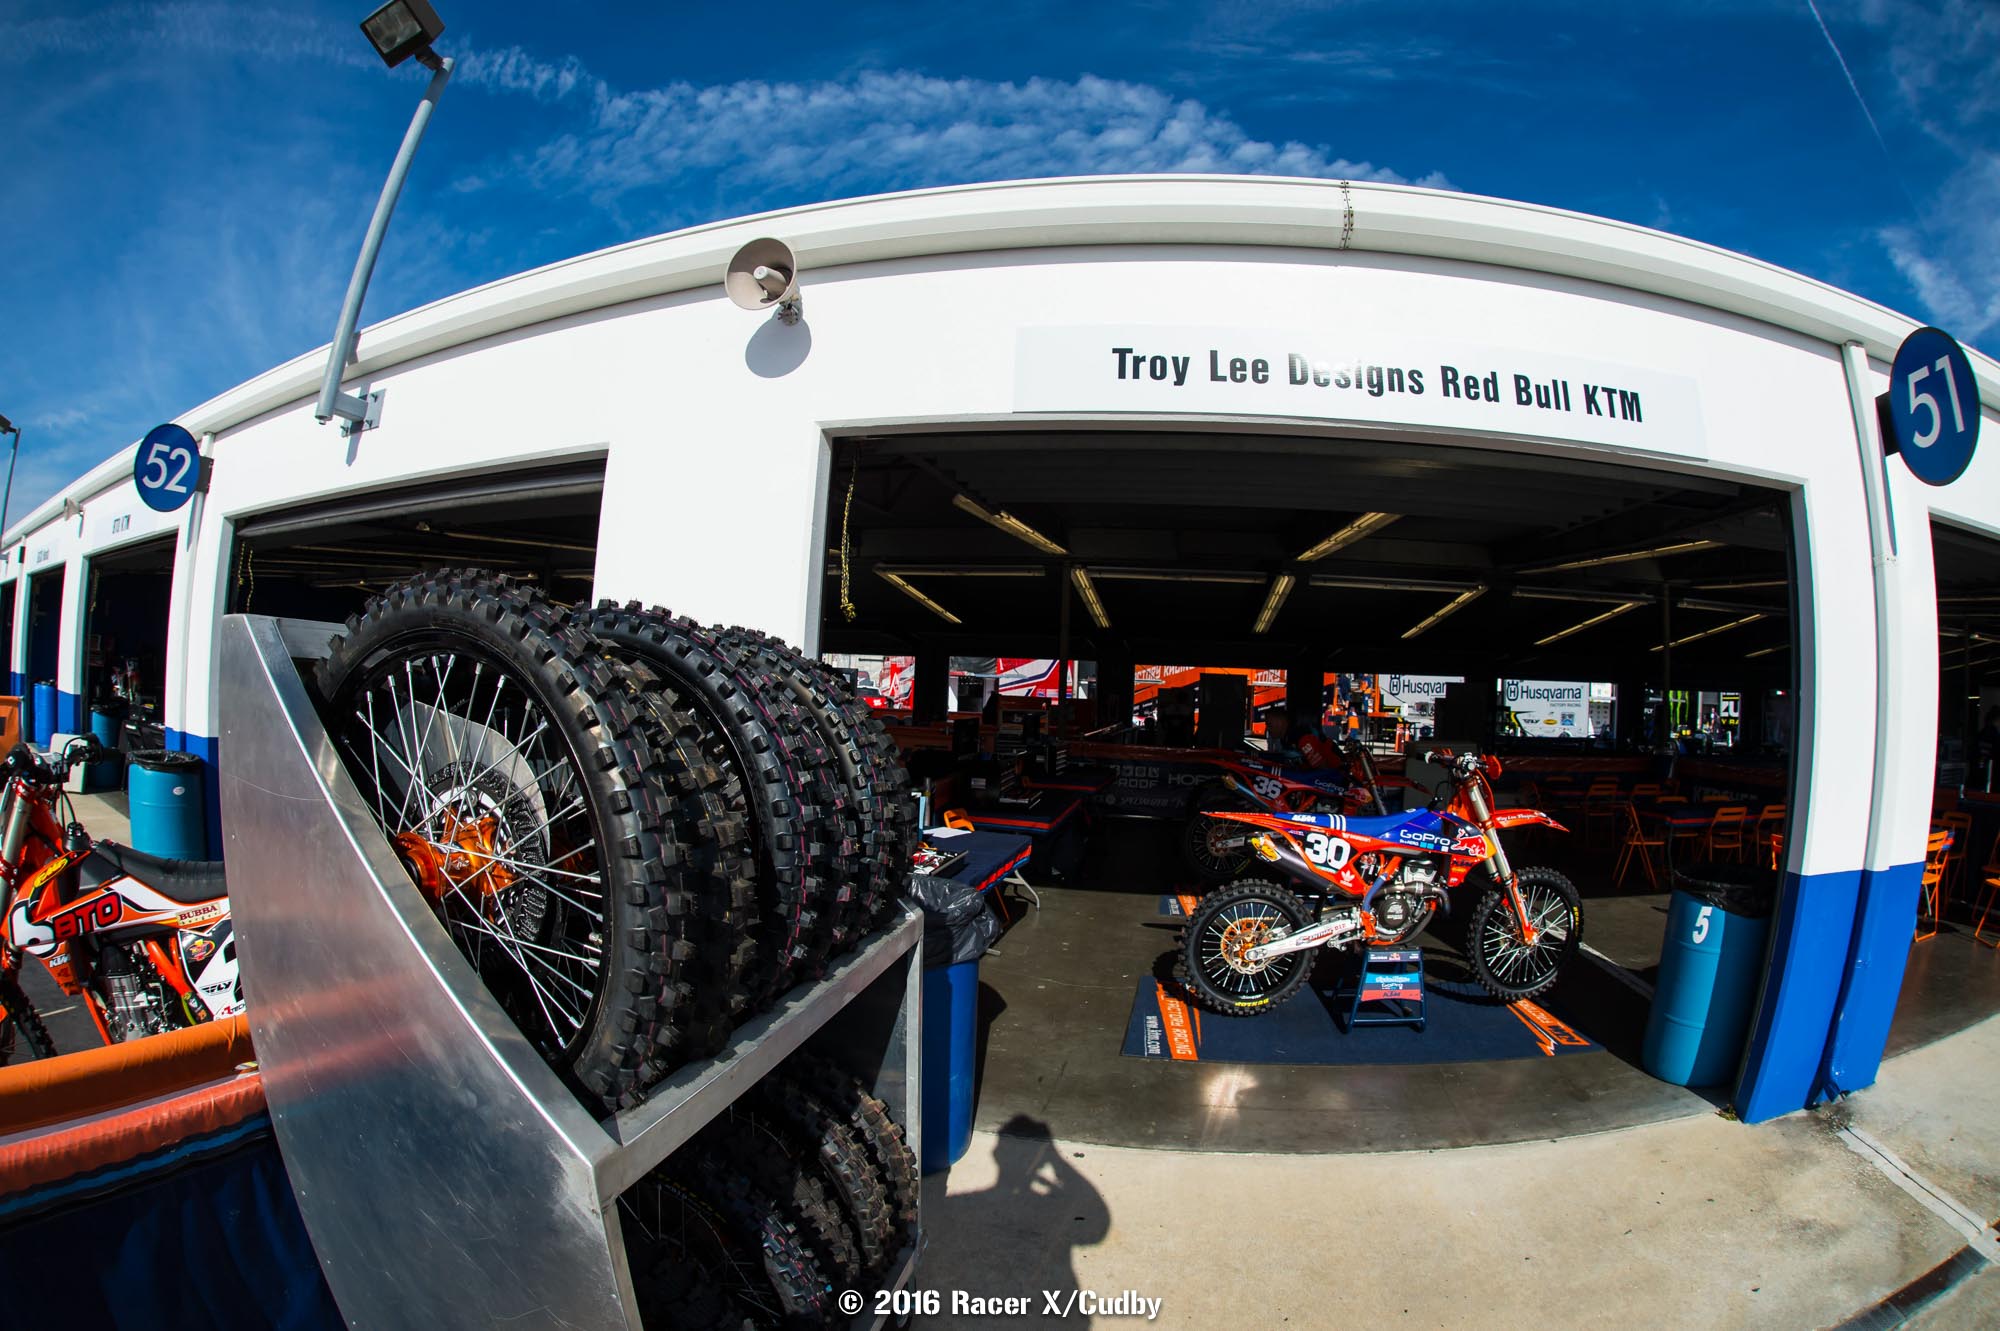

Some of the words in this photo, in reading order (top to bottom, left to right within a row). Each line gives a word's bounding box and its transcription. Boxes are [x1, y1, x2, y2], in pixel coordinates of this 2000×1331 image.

[1112, 347, 1190, 386] Troy
[1210, 350, 1269, 384] Lee
[1288, 352, 1425, 397] Designs
[1440, 365, 1500, 402] Red
[1514, 373, 1571, 412] Bull
[1583, 383, 1642, 422] KTM
[1907, 354, 1965, 448] 51
[142, 442, 192, 494] 52
[1521, 686, 1581, 702] Husqvarna
[1253, 775, 1283, 800] 36
[1304, 831, 1351, 871] 30
[1399, 829, 1451, 846] GoPro
[53, 892, 121, 941] BTO
[179, 904, 218, 921] BUBBA
[1692, 905, 1712, 944] 5
